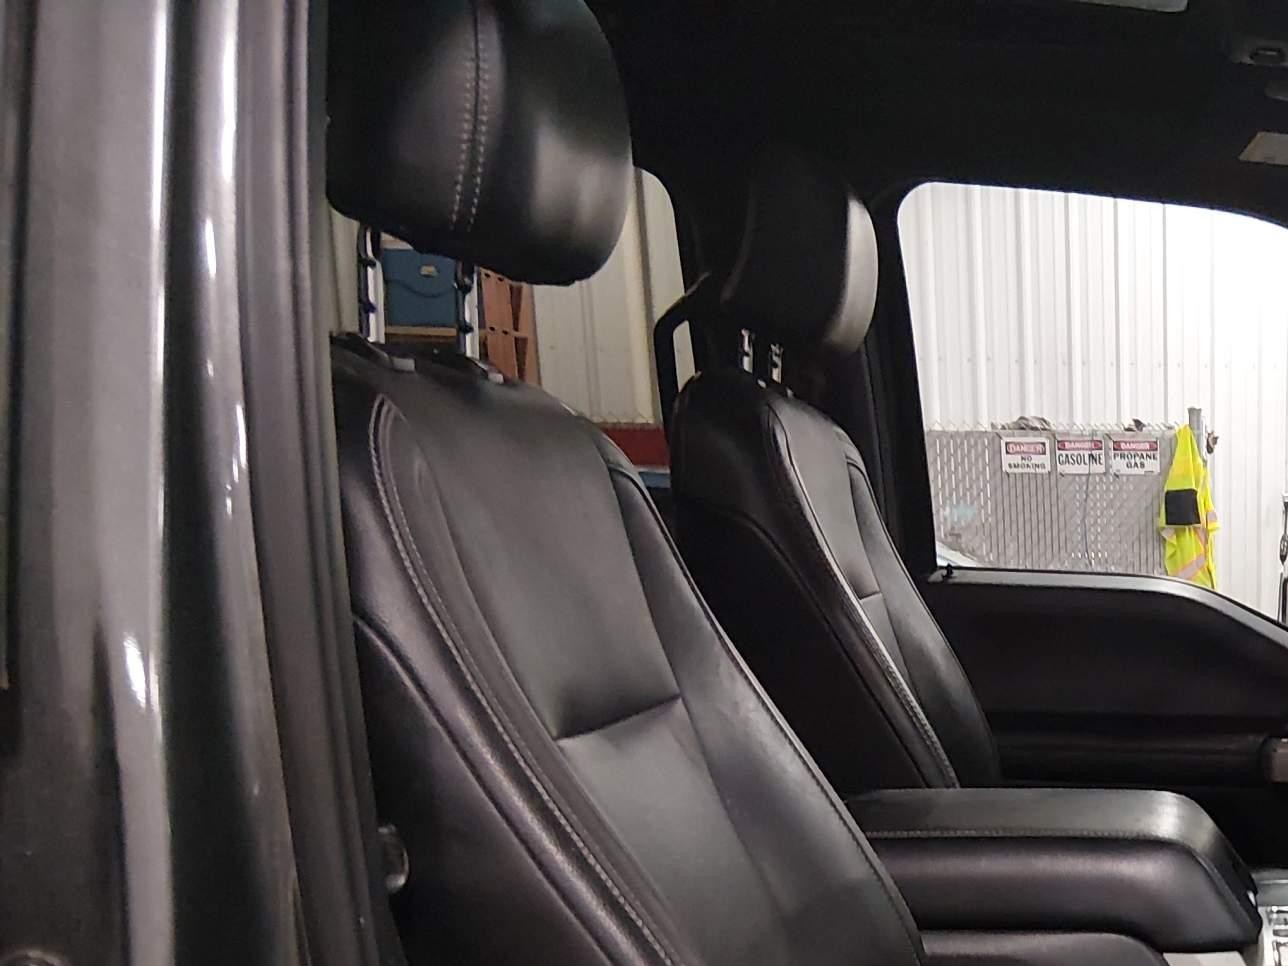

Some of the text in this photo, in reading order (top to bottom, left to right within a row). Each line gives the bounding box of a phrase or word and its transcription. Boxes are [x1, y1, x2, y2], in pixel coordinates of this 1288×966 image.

[1057, 453, 1103, 465] GASOLINE
[1113, 452, 1158, 460] PROPANE
[1008, 462, 1046, 470] SMOKING
[1125, 461, 1146, 469] GAS
